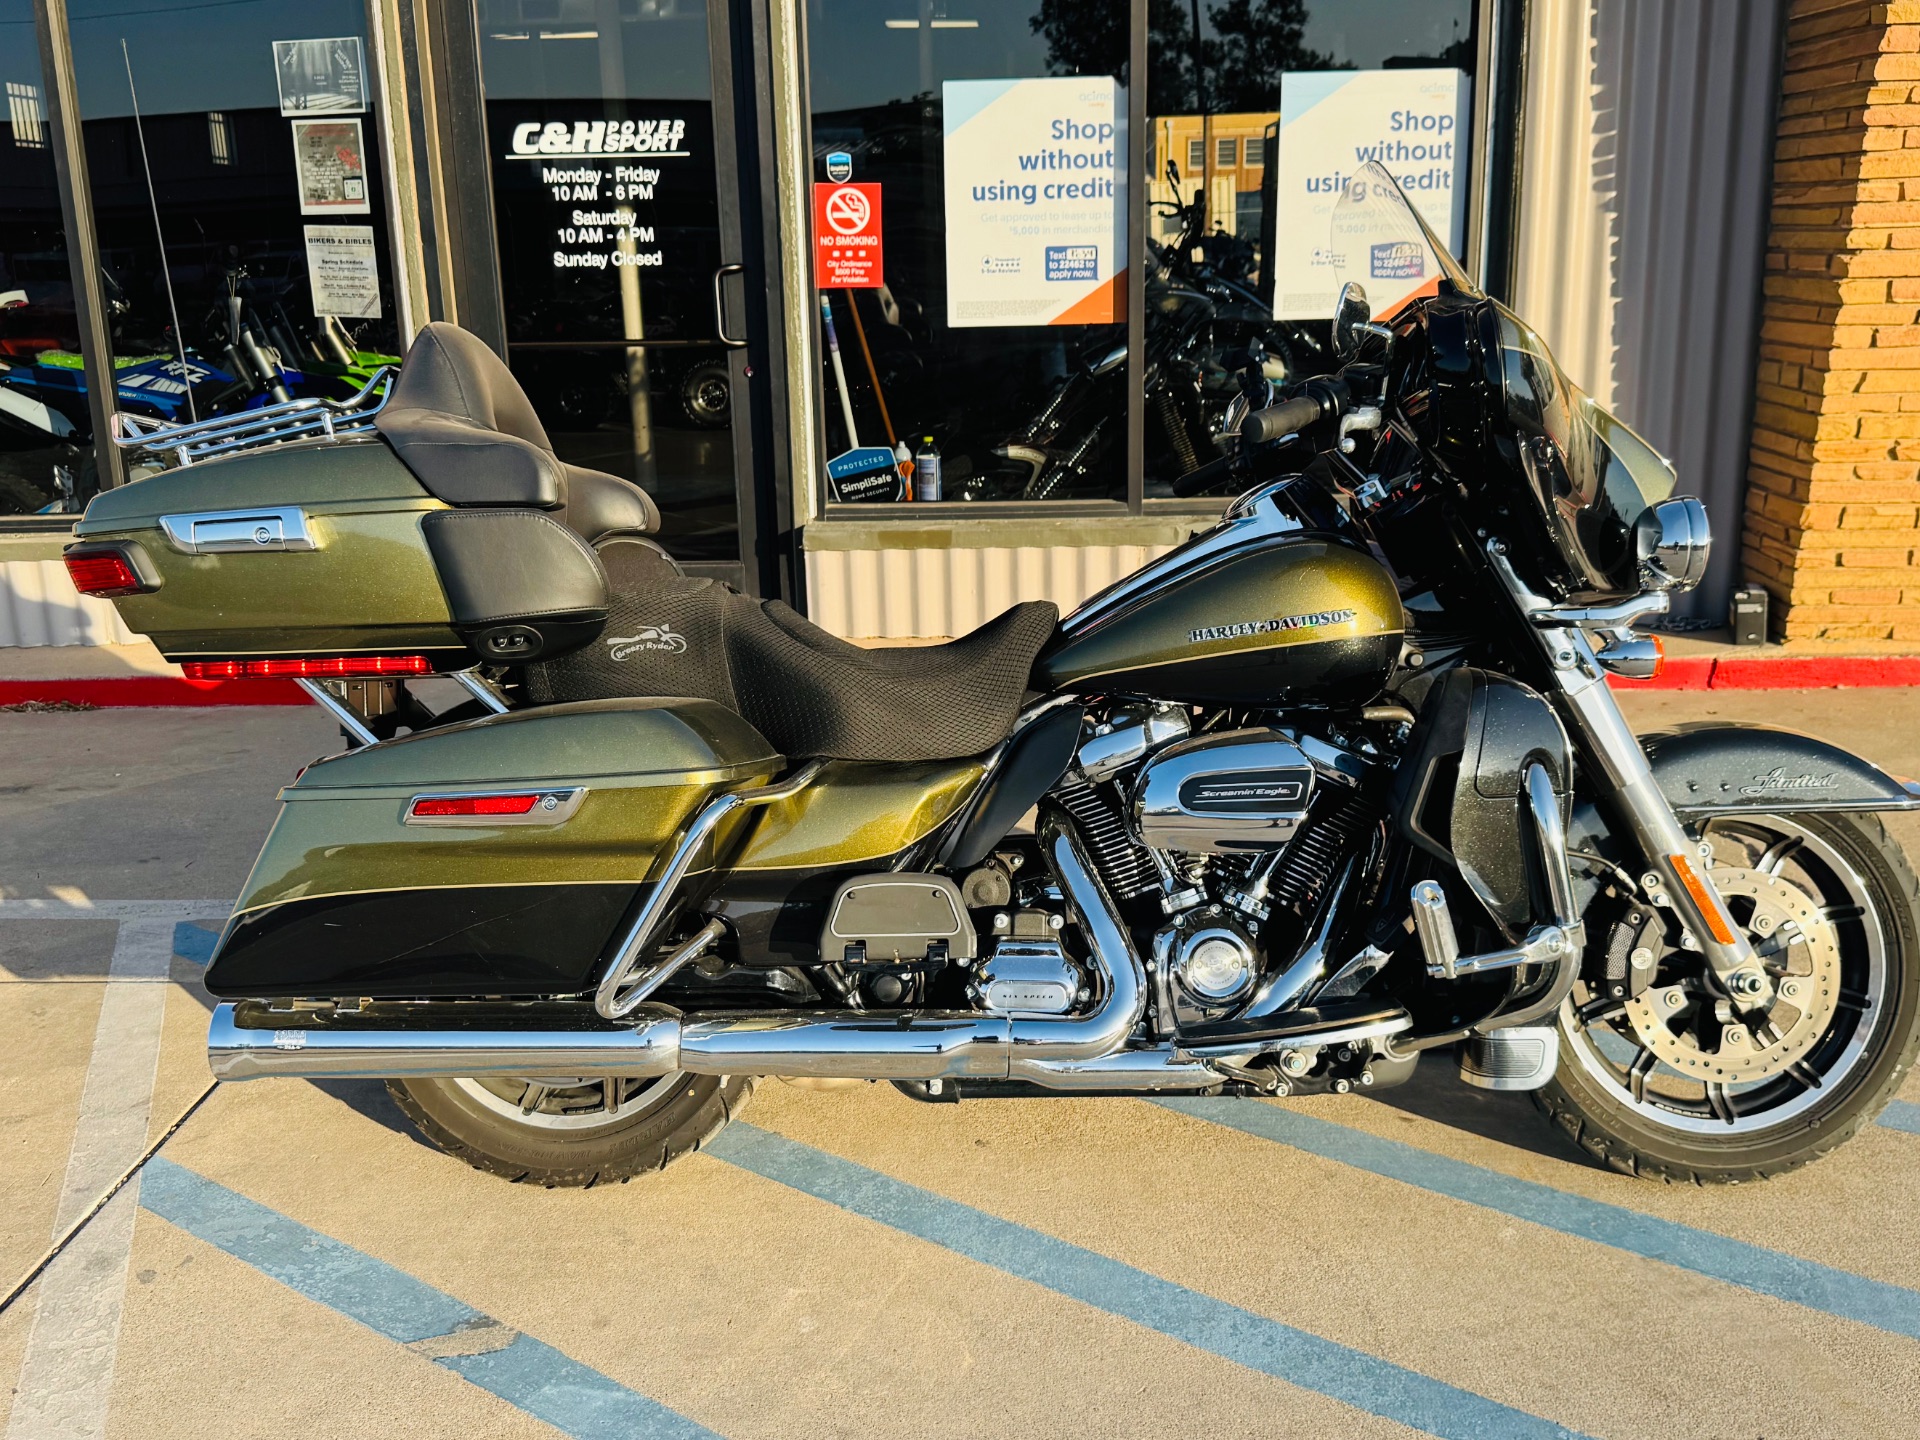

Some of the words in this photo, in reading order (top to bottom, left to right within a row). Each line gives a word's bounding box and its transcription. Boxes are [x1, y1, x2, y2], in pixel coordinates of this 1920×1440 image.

[1051, 118, 1114, 144] Shop
[1390, 110, 1454, 135] Shop
[512, 121, 606, 154] C&H
[607, 119, 685, 134] POWER
[604, 132, 684, 152] SPORT
[1355, 140, 1452, 162] without
[1018, 149, 1114, 171] without
[542, 166, 602, 185] Monday
[615, 166, 660, 184] Friday
[552, 185, 571, 201] 10
[572, 186, 598, 201] AM
[615, 184, 625, 200] 6
[628, 184, 653, 200] PM
[972, 179, 1037, 205] using
[1043, 177, 1114, 199] credit
[572, 209, 637, 227] Saturday
[981, 213, 998, 223] Get
[1000, 212, 1047, 226] approved
[1049, 212, 1060, 221] to
[1061, 211, 1087, 221] lease
[1089, 211, 1101, 222] up
[557, 228, 576, 244] 10
[578, 228, 603, 244] AM
[616, 228, 626, 242] 4
[630, 227, 655, 243] PM
[1010, 226, 1040, 236] $5,000
[1042, 225, 1051, 234] in
[345, 238, 372, 246] BIBLES
[820, 235, 834, 246] NO
[835, 235, 878, 246] SMOKING
[553, 251, 608, 269] Sunday
[611, 250, 662, 266] Closed
[1049, 251, 1066, 260] Text
[1374, 249, 1391, 258] Text
[827, 260, 840, 269] City
[840, 260, 873, 268] Ordinance
[851, 267, 865, 275] Fine
[1049, 260, 1059, 269] to
[1086, 260, 1095, 268] to
[1374, 259, 1382, 267] to
[842, 275, 869, 283] Violation
[1049, 269, 1071, 280] apply
[1373, 268, 1395, 277] apply
[837, 455, 884, 472] PROTECTED
[840, 473, 892, 493] SimpliSafe
[866, 486, 890, 497] SECURITY
[615, 642, 645, 659] Breezy
[1739, 766, 1840, 797] Limited
[1256, 787, 1291, 796] Eagle
